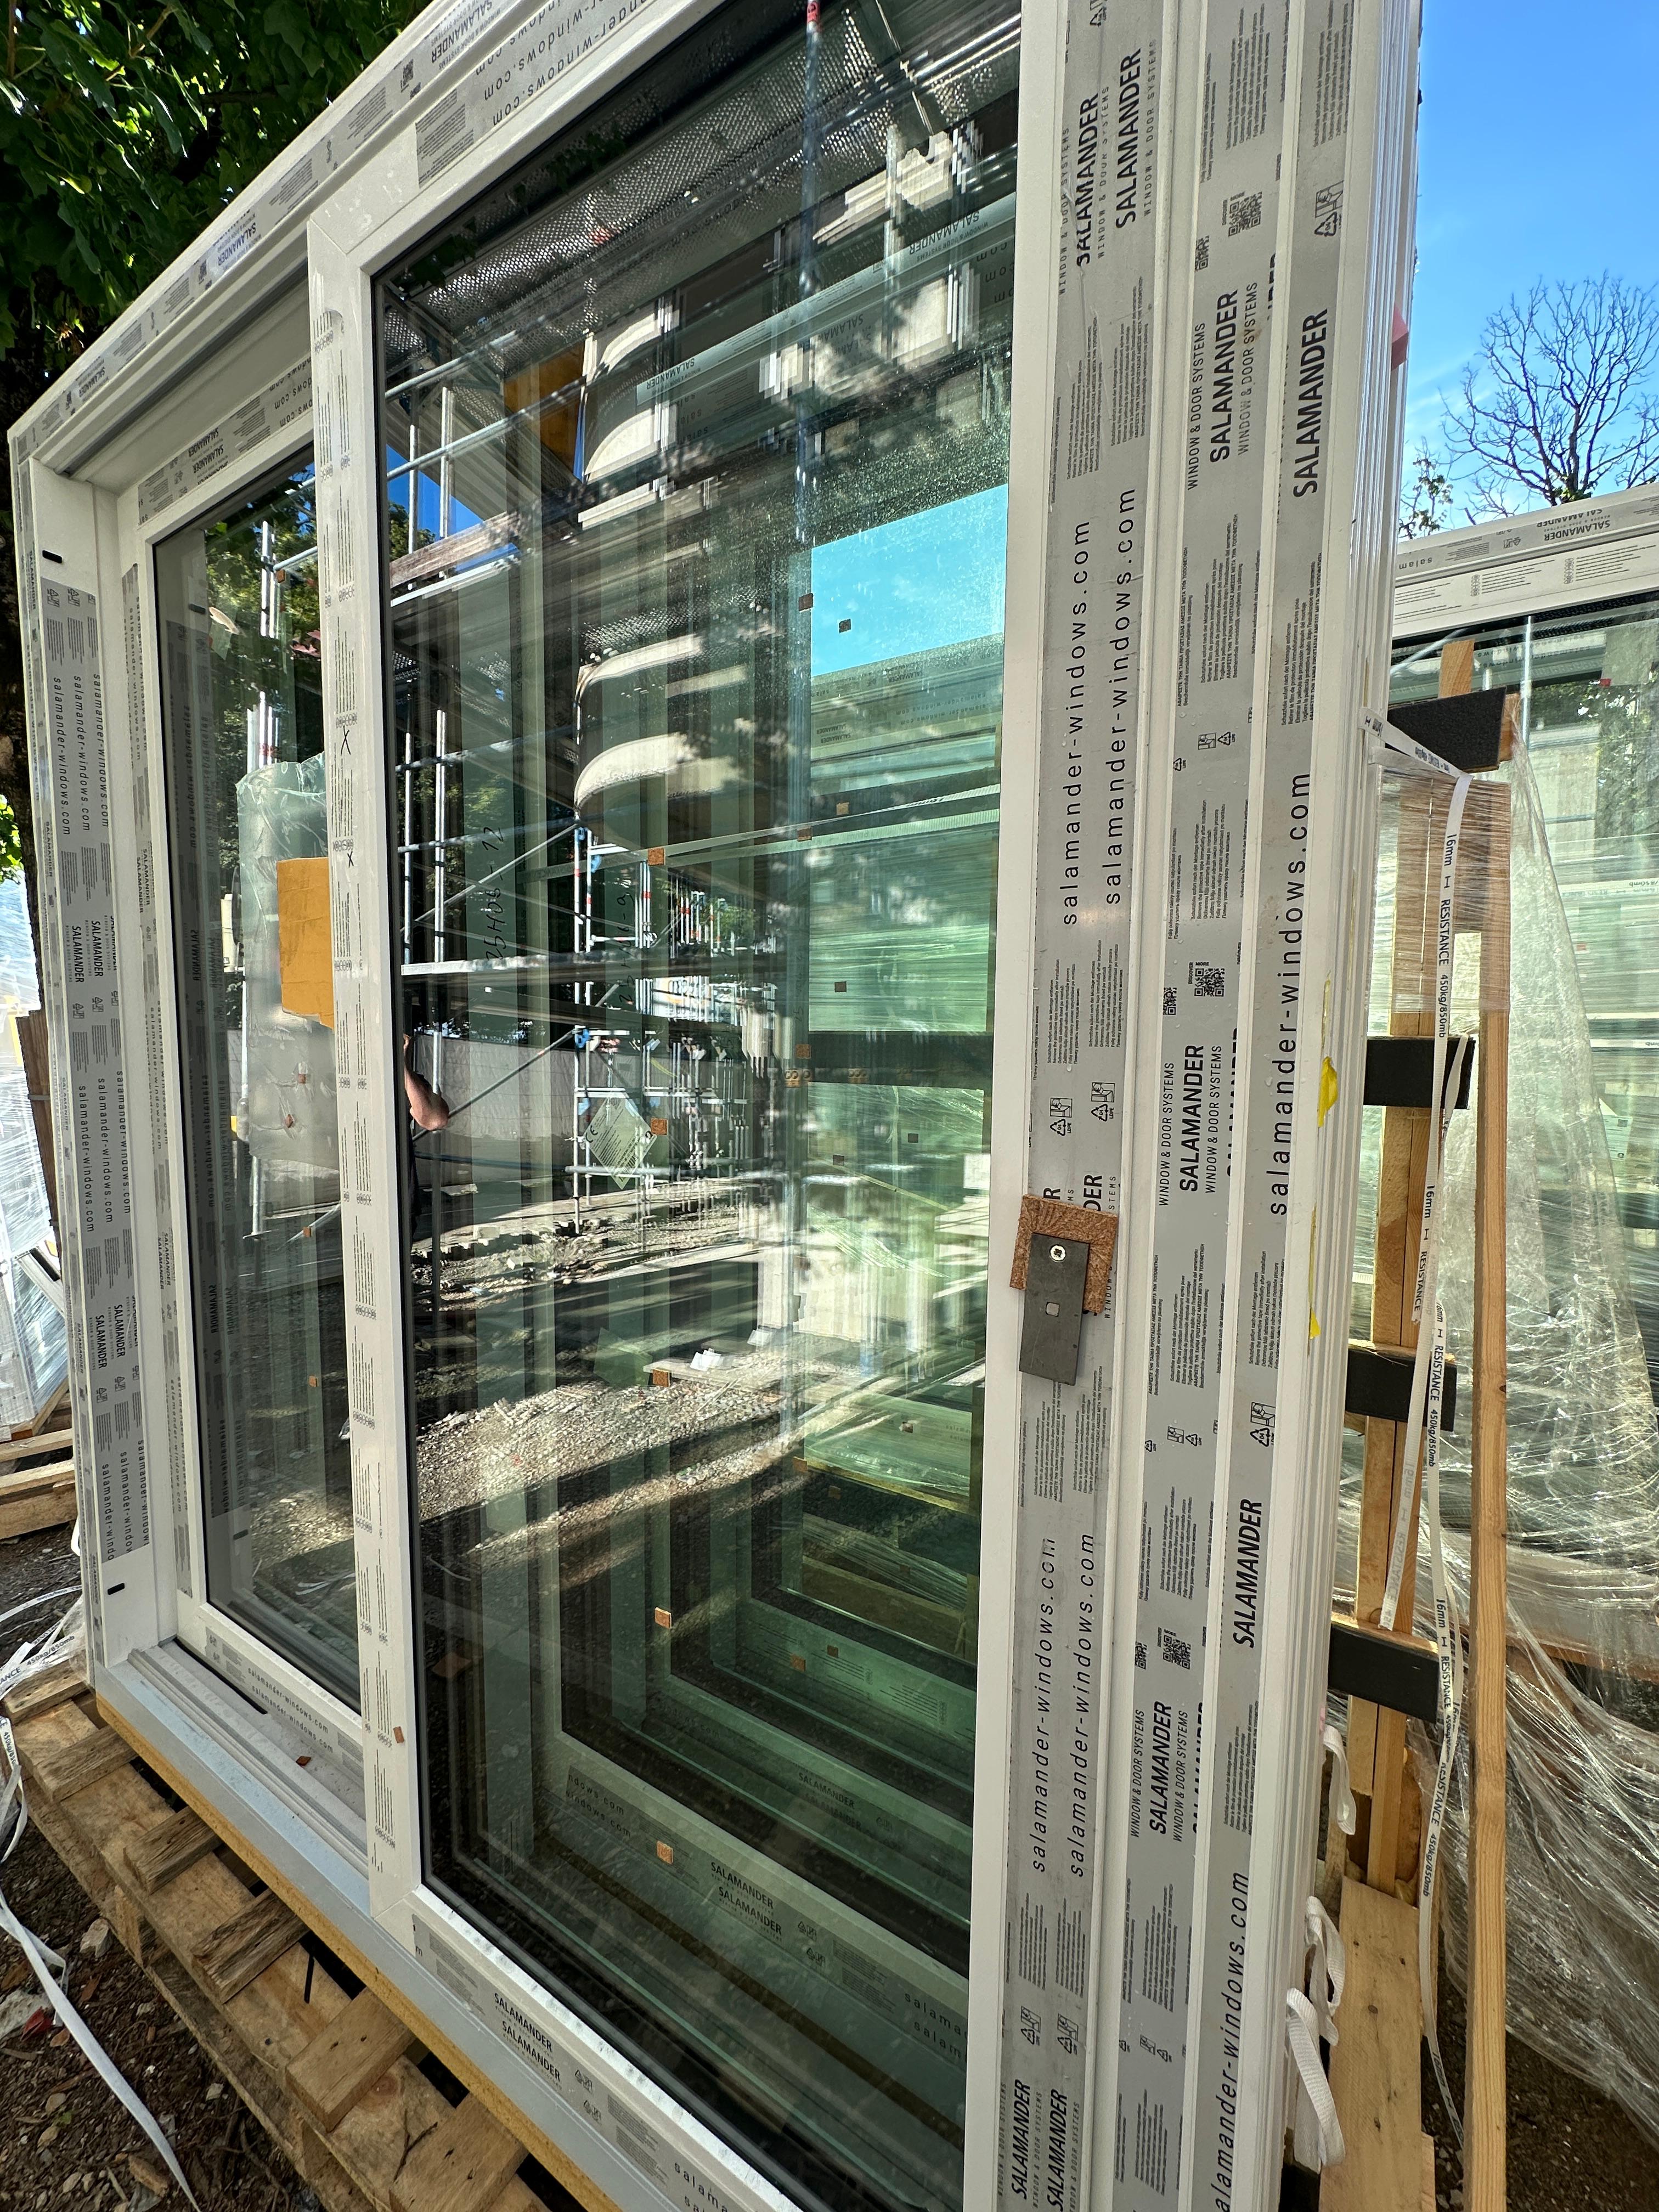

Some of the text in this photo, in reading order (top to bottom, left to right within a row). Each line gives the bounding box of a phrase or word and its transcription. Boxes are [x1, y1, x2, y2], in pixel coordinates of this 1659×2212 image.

[1115, 48, 1141, 229] SALAMANDER
[1145, 149, 1153, 157] &
[1146, 108, 1154, 143] DOOR
[1075, 93, 1098, 267] SALAMANDER
[1143, 165, 1153, 217] WINDOW
[909, 210, 979, 255] SALAMANDER
[1097, 210, 1105, 259] WINDOW
[1210, 290, 1238, 462] SALAMANDER
[1237, 283, 1258, 456] WINDOW & DOOR SYSTEMS
[1187, 323, 1205, 490] WINDOW & DOOR SYSTEMS
[1293, 308, 1328, 498] SALAMANDER
[187, 427, 219, 458] SALAMANDER
[192, 444, 224, 473] SALAMANDER
[1544, 520, 1611, 542] SALAMANDER
[1059, 522, 1090, 925] salamander-windows.com
[1102, 489, 1135, 904] salamander-windows.com
[53, 678, 72, 836] salamander-windows.com
[73, 676, 91, 831] salamander-windows.com
[143, 849, 151, 906] SALAMANDER
[1444, 833, 1457, 866] 16mm
[71, 926, 85, 983] SALAMANDER
[91, 920, 104, 977] SALAMANDER
[1438, 899, 1452, 966] RESISTANCE
[1266, 774, 1310, 1215] salamander-windows.com
[1437, 974, 1448, 1039] 450kg/850mb
[1163, 1063, 1174, 1114] SYSTEMS
[1209, 1046, 1222, 1098] SYSTEMS
[1161, 1118, 1172, 1147] DOOR
[1180, 1045, 1204, 1192] SALAMANDER
[1207, 1102, 1220, 1133] DOOR
[78, 1086, 97, 1233] salamander-windows.com
[98, 1078, 115, 1223] salamander-windows.com
[1205, 1146, 1217, 1193] WINDOW
[1159, 1160, 1170, 1206] WINDOW
[1423, 1185, 1435, 1218] 16mm
[1414, 1250, 1428, 1311] RESISTANCE
[95, 1314, 107, 1369] SALAMANDER
[114, 1304, 126, 1357] SALAMANDER
[1430, 1345, 1444, 1402] RESISTANCE
[1427, 1409, 1438, 1468] 450kg/850mb
[1233, 1499, 1262, 1649] SALAMANDER
[1436, 1598, 1447, 1628] 16mm
[26, 1635, 75, 1666] 450kg/850mb
[1029, 1539, 1055, 1872] salamander-windows.com
[1066, 1534, 1094, 1877] salamander-windows.com
[1441, 1656, 1452, 1709] RESISTANCE
[1133, 1709, 1144, 1757] SYSTEMS
[1176, 1711, 1188, 1758] SYSTEMS
[798, 1772, 855, 1810] SALAMANDER
[1132, 1758, 1142, 1787] DOOR
[1149, 1701, 1171, 1835] SALAMANDER
[1175, 1760, 1186, 1790] DOOR
[1130, 1795, 1141, 1838] WINDOW
[1173, 1798, 1184, 1842] WINDOW
[711, 1863, 775, 1910] SALAMANDER
[1422, 1833, 1438, 1897] 450kg/850mb
[718, 1888, 782, 1936] SALAMANDER
[494, 1993, 553, 2053] SALAMANDER
[502, 2021, 561, 2082] SALAMANDER
[1011, 2079, 1030, 2200] SALAMANDER
[1047, 2089, 1067, 2212] SALAMANDER
